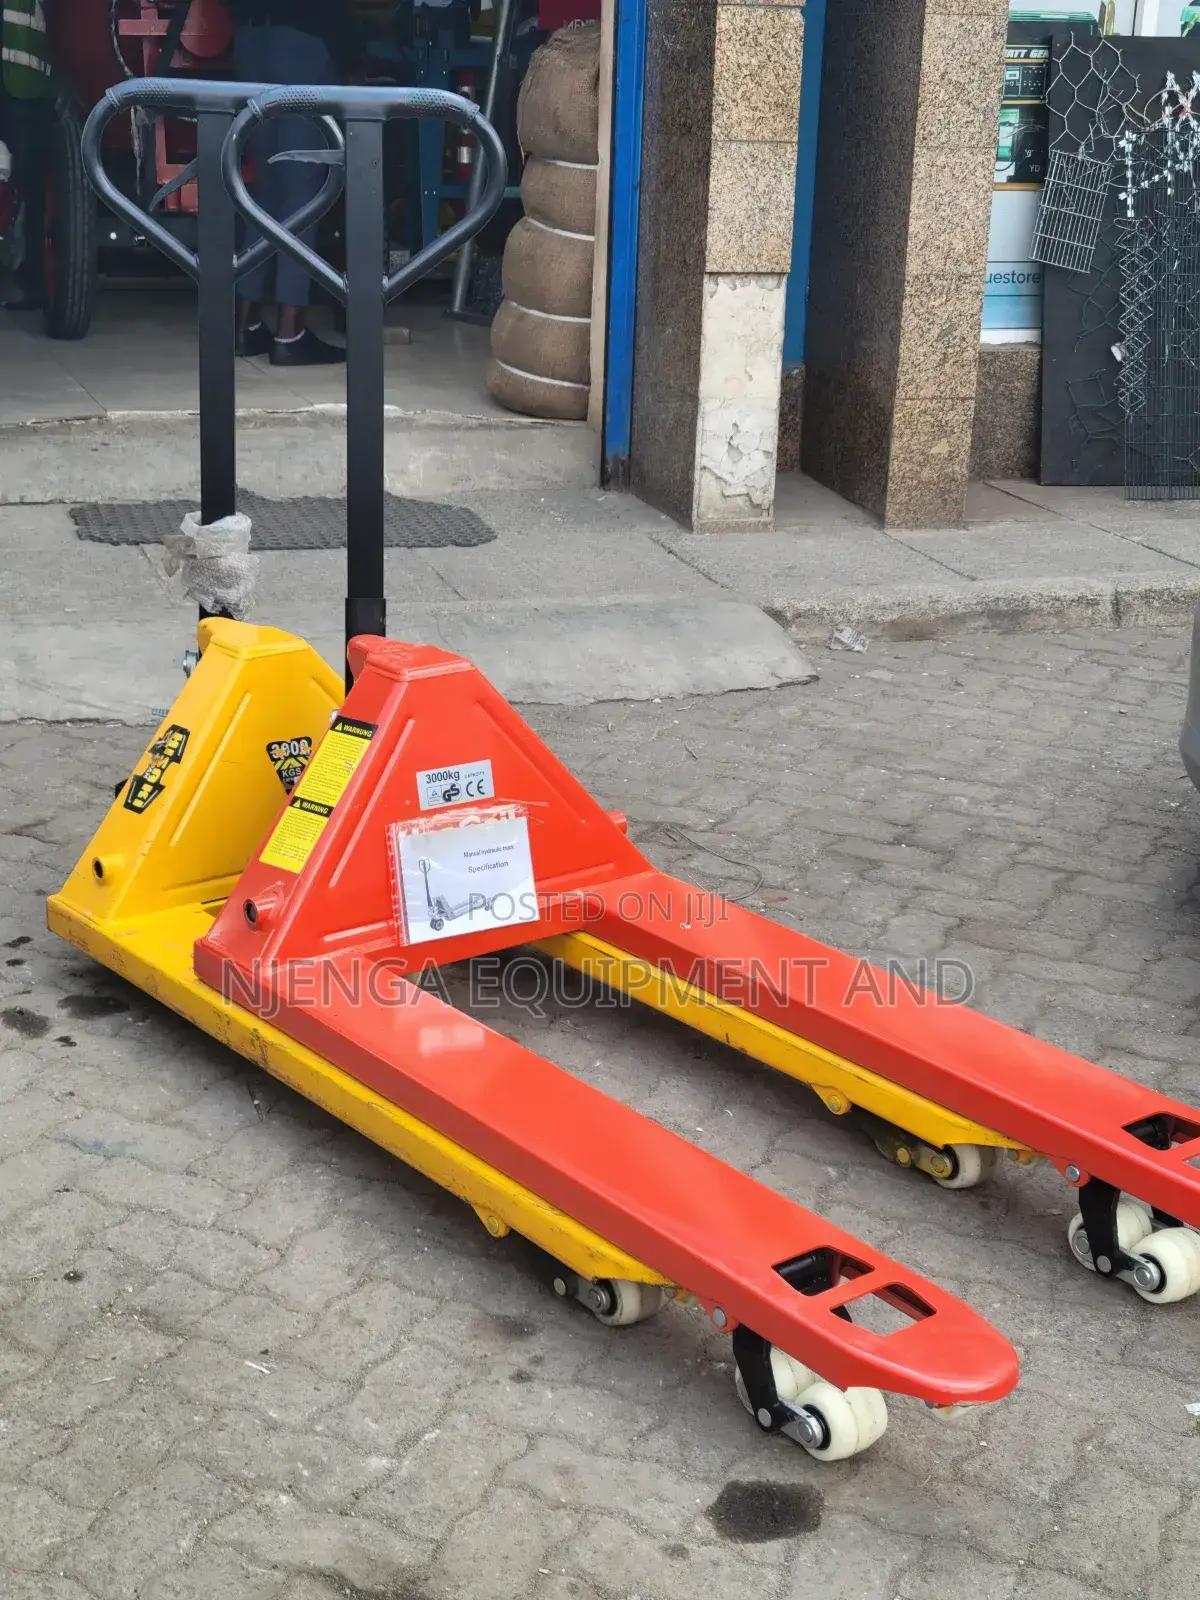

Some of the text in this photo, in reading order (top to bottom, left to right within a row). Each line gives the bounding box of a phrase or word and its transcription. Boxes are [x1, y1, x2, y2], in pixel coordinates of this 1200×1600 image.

[281, 767, 302, 778] KGS
[425, 770, 460, 784] 3000kg
[465, 779, 486, 798] CE
[468, 860, 509, 874] Specification
